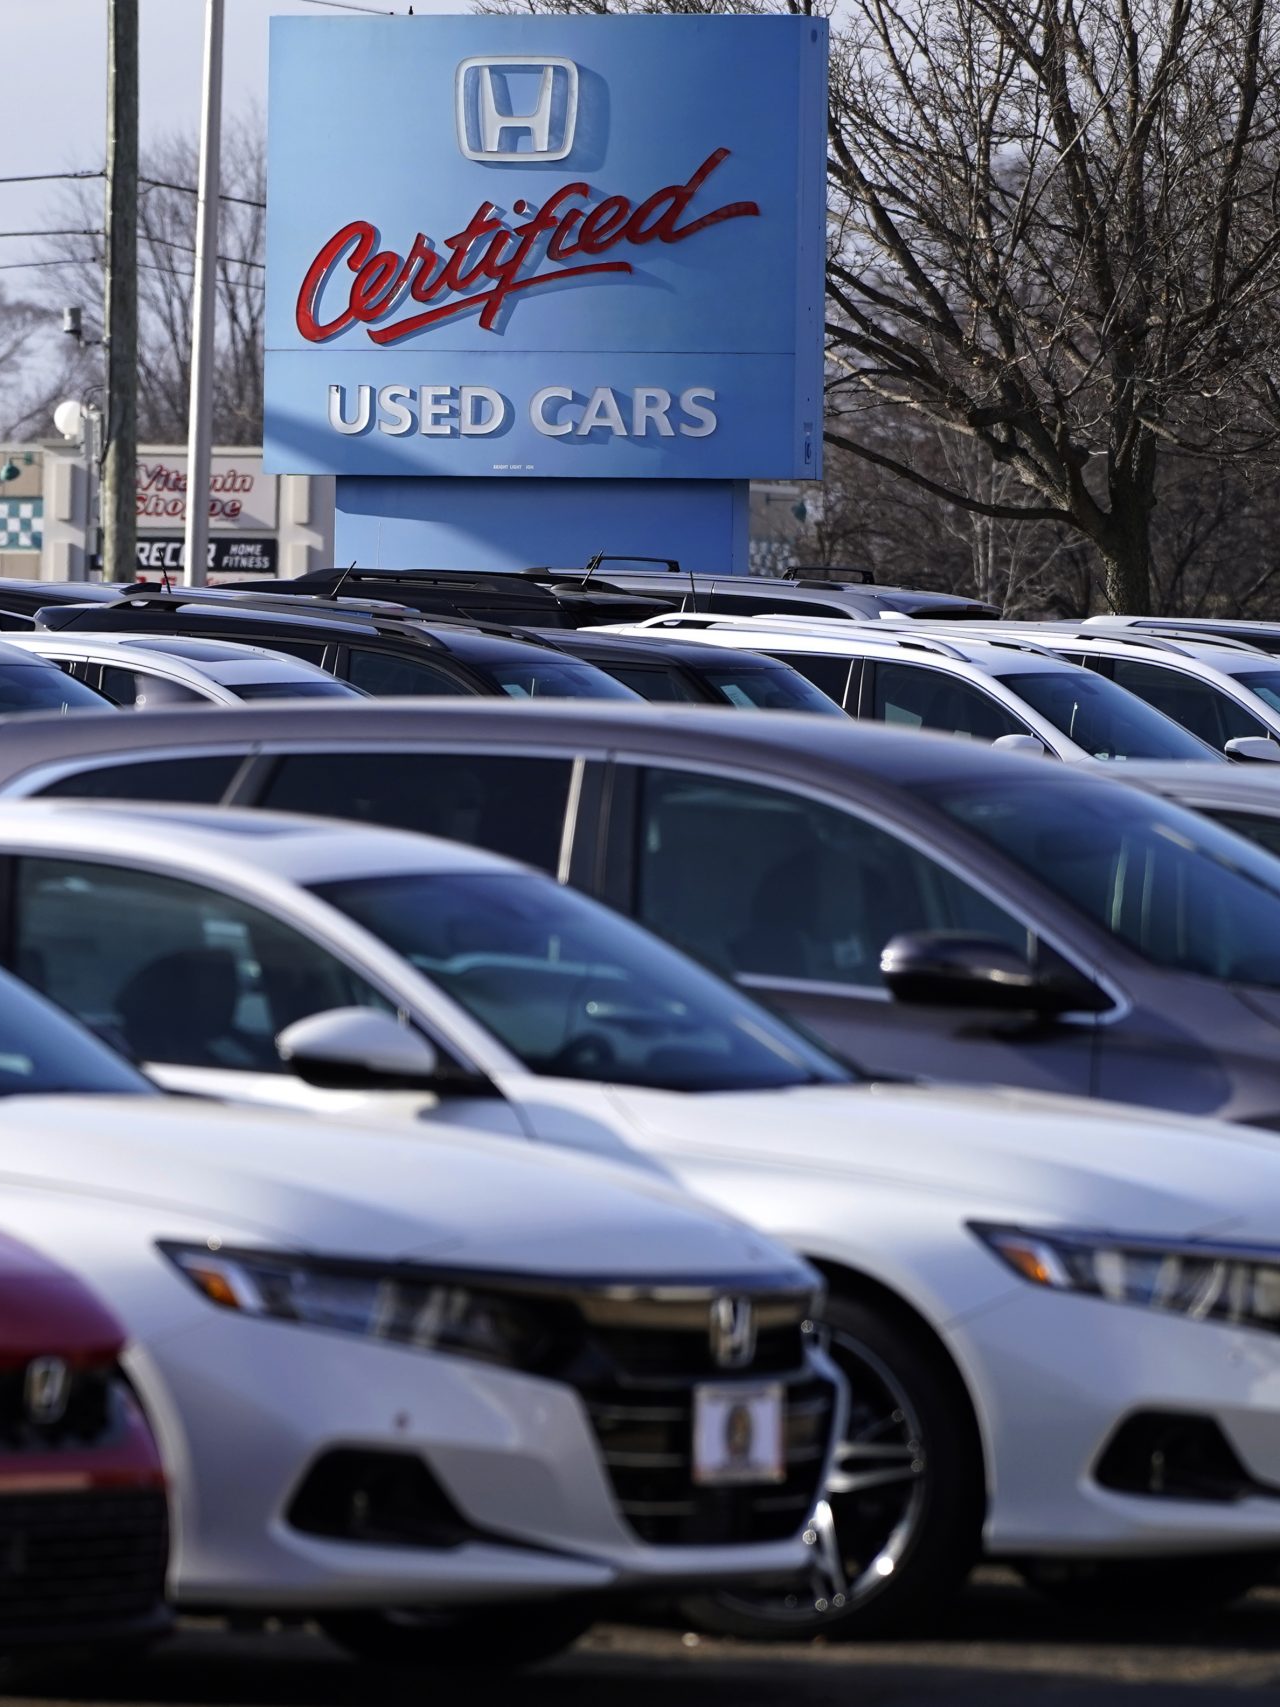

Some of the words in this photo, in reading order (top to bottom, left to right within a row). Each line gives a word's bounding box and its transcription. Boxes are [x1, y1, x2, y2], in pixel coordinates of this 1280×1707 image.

[296, 147, 760, 346] Certified
[327, 384, 506, 437] USED
[529, 386, 718, 438] CARS
[221, 555, 270, 569] FITNESS
[229, 543, 263, 556] HOME
